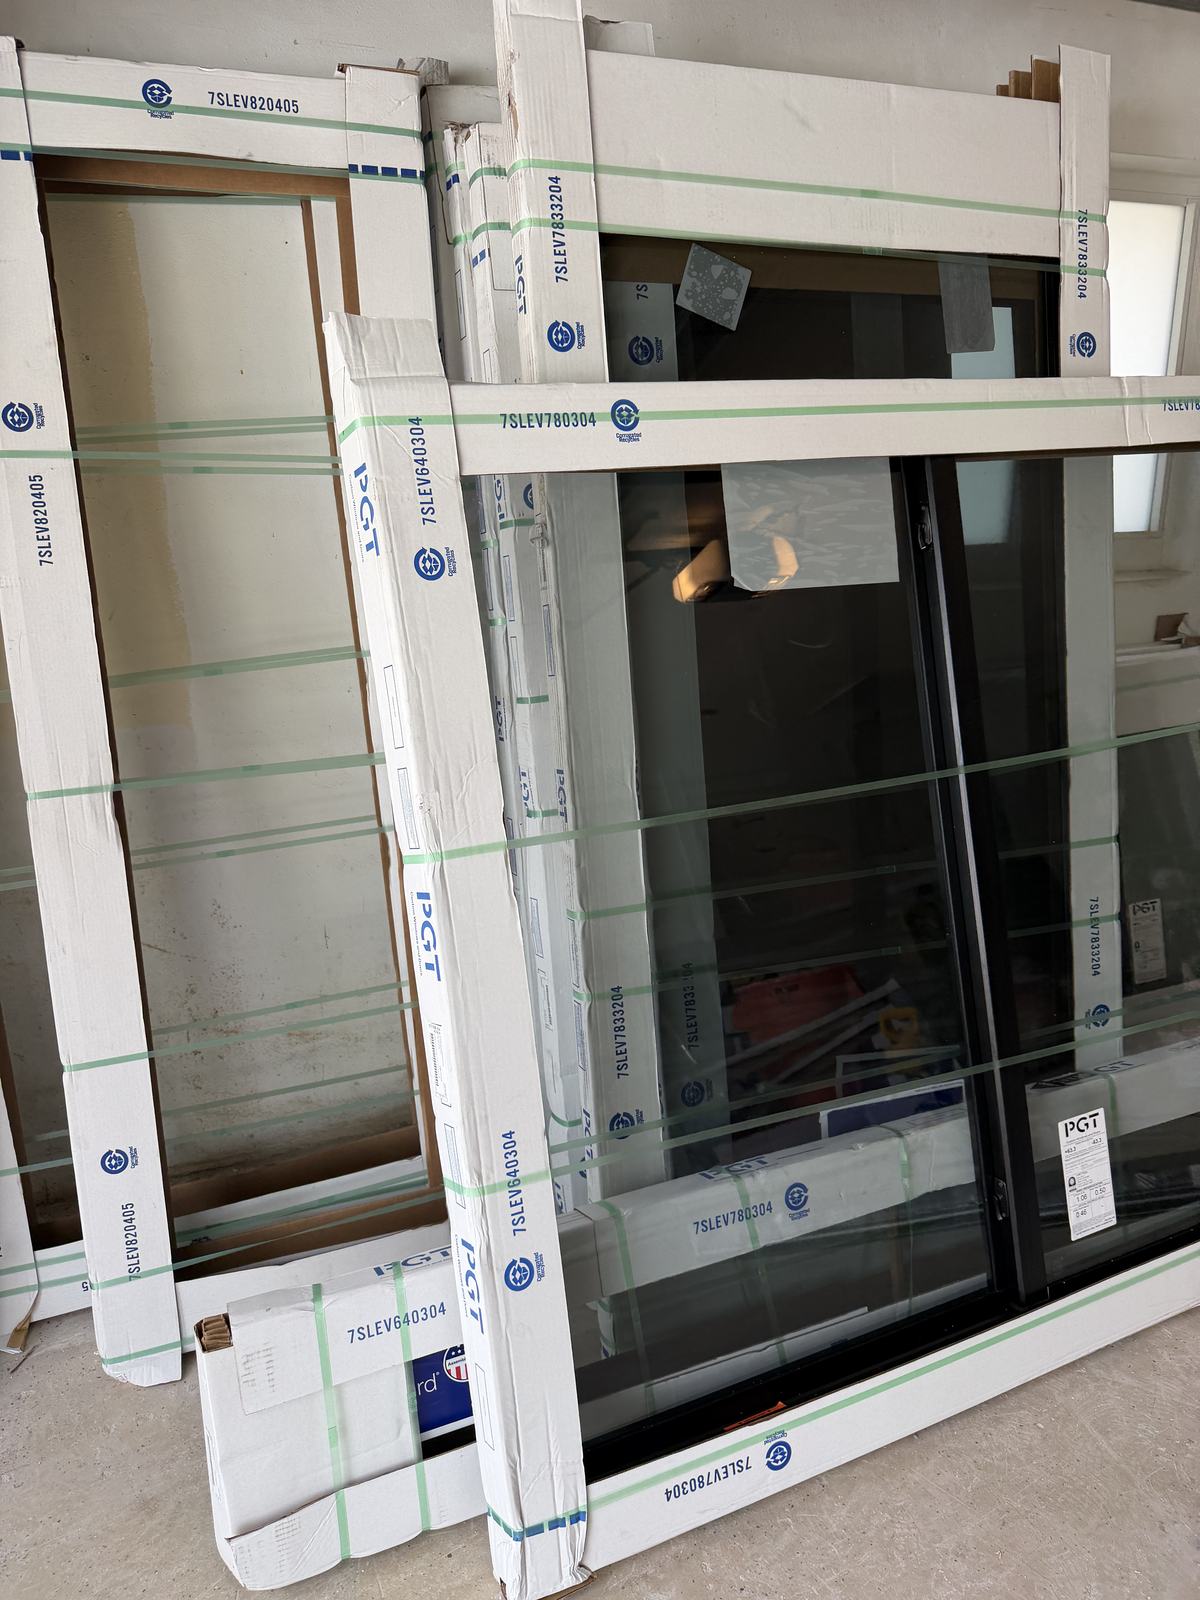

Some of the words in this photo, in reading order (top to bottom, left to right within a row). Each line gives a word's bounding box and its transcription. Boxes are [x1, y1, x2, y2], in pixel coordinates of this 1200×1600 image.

[208, 91, 299, 114] 7SLEV820405
[548, 175, 569, 283] 7SLEV7833204
[1077, 209, 1088, 299] 7SLEV7833204
[514, 254, 527, 315] PGT
[499, 412, 597, 429] 7SLEV780304
[354, 462, 381, 557] PGT
[408, 416, 437, 526] 7SLEV640304
[29, 474, 54, 567] 7SLEV820405
[556, 768, 568, 823] PGT
[416, 891, 441, 982] PGT
[1089, 896, 1101, 977] 7SLEV7833204
[611, 985, 629, 1080] 7SLEV7833204
[681, 962, 700, 1049] 7SLEV783304
[1064, 1112, 1100, 1138] PGT
[502, 1130, 527, 1237] 7SLEV640304
[693, 1200, 773, 1235] 7SLEV780304
[121, 1202, 142, 1282] 7SLEV820405
[347, 1301, 447, 1344] 7SLEV640304
[461, 1238, 484, 1335] PGT
[664, 1456, 753, 1502] 7SLEV780304
